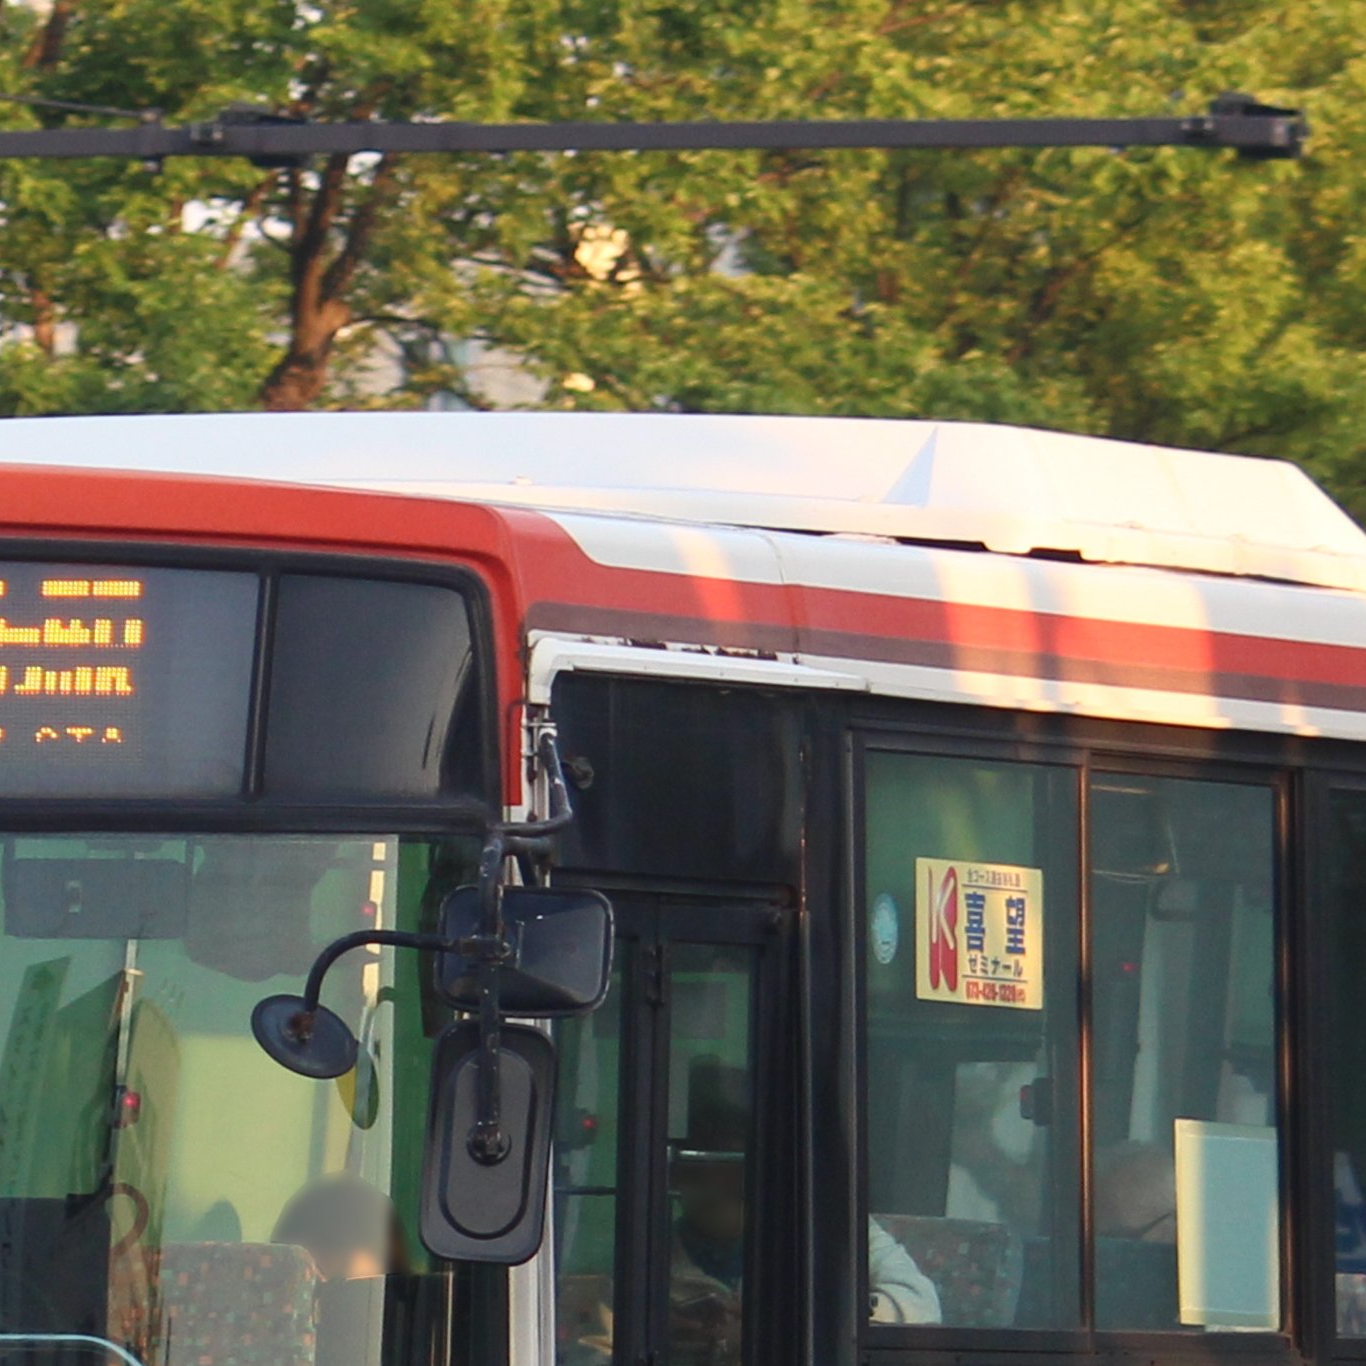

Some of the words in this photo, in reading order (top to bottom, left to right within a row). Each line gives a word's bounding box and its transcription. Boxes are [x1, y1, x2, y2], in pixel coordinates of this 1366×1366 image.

[968, 955, 1024, 979] ゼミナール
